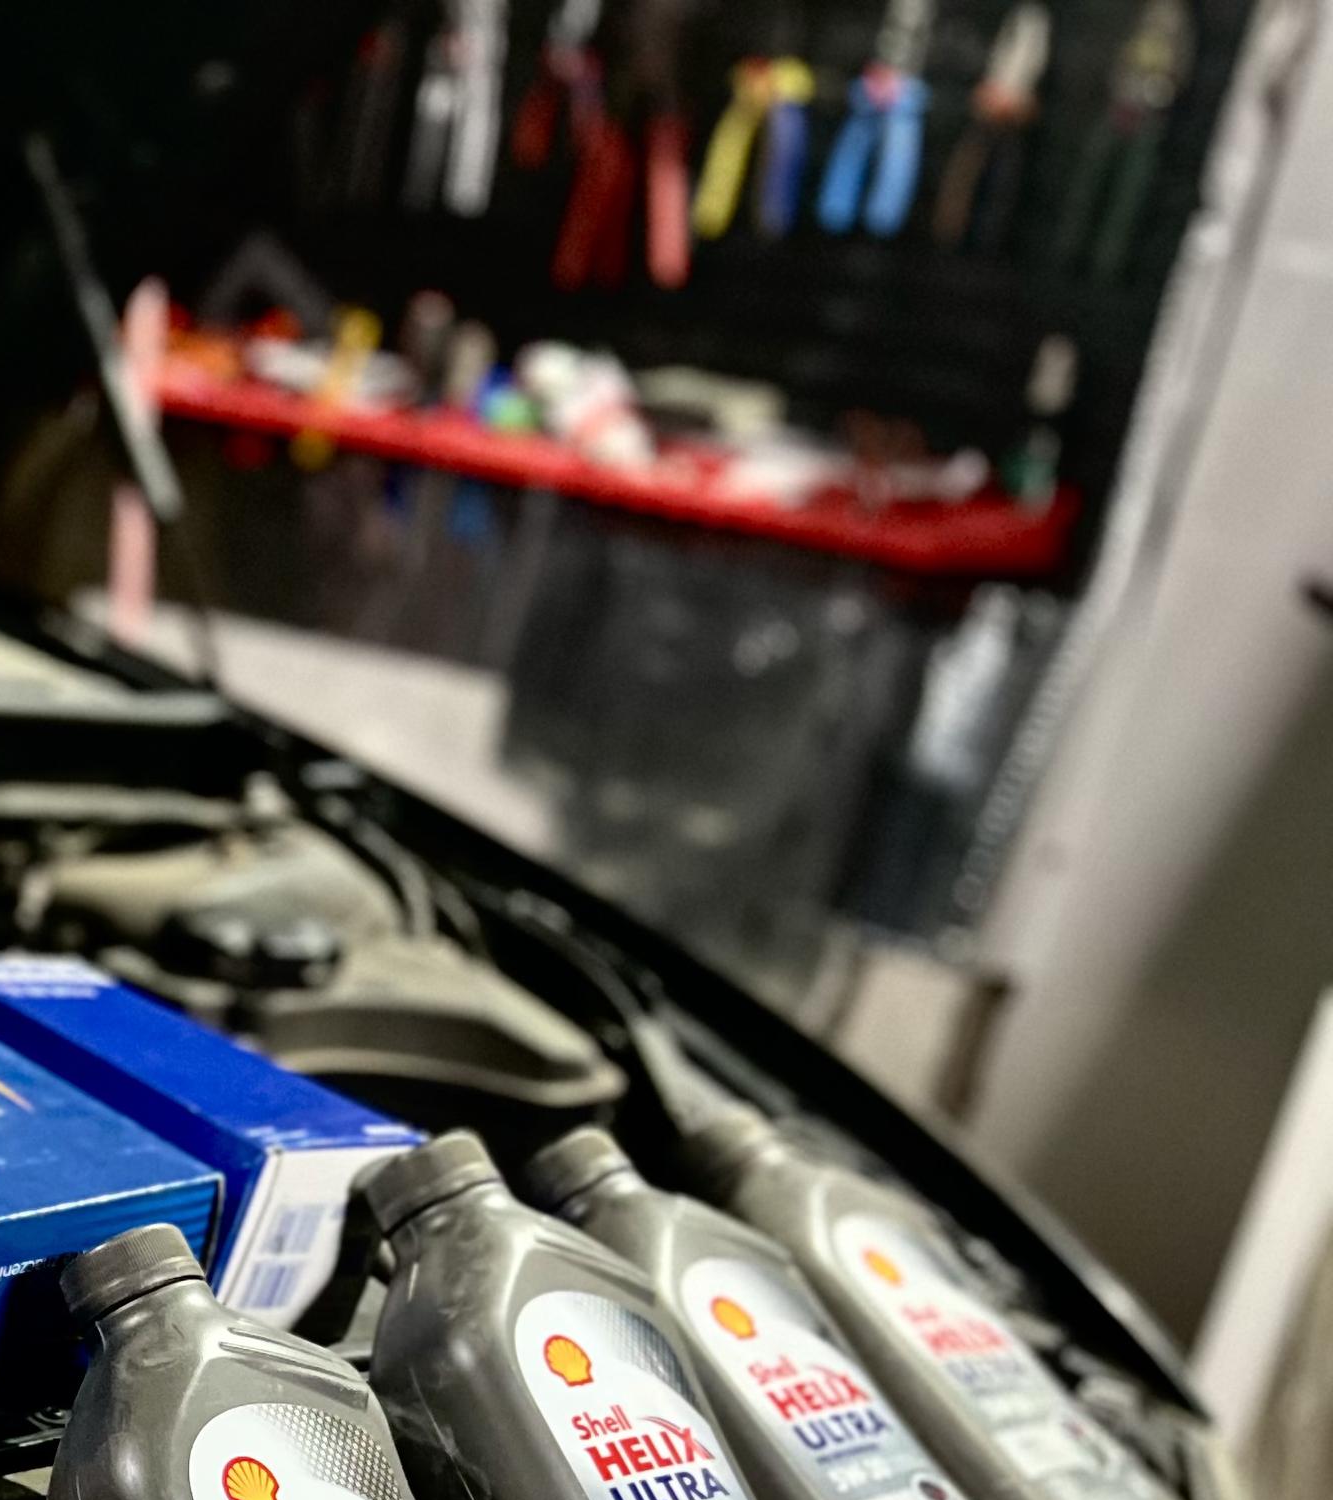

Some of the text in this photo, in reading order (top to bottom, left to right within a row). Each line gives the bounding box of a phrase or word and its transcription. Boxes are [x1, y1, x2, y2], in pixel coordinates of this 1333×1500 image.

[767, 1374, 870, 1421] HELIX
[571, 1404, 632, 1441] Shell
[793, 1408, 890, 1450] ULTRA
[586, 1427, 716, 1482] HELIX
